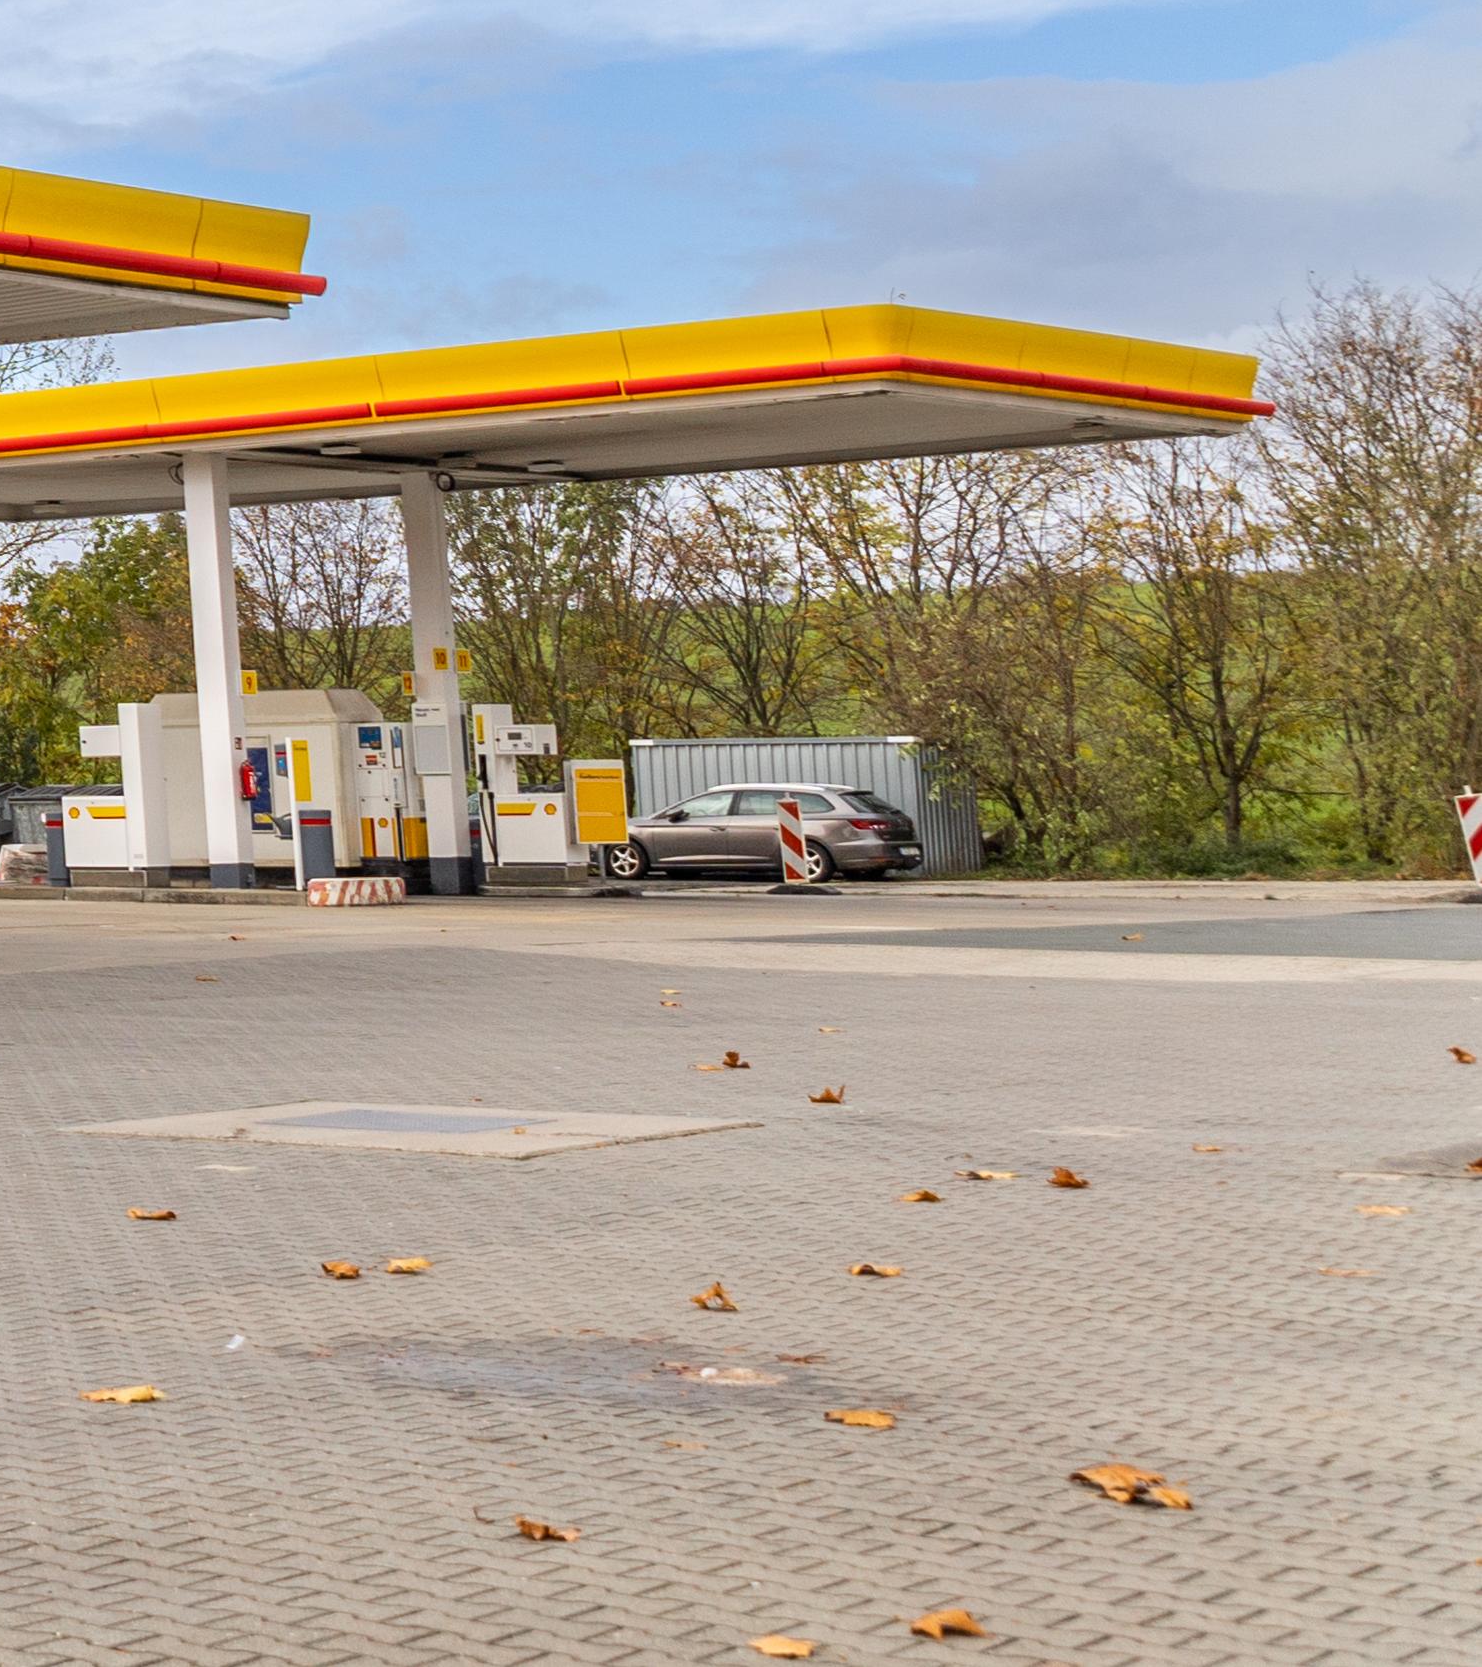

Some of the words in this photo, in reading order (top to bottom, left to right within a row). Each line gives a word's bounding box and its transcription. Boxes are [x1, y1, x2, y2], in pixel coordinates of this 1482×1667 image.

[435, 652, 446, 665] 10
[458, 654, 468, 668] 11
[246, 676, 252, 690] 9
